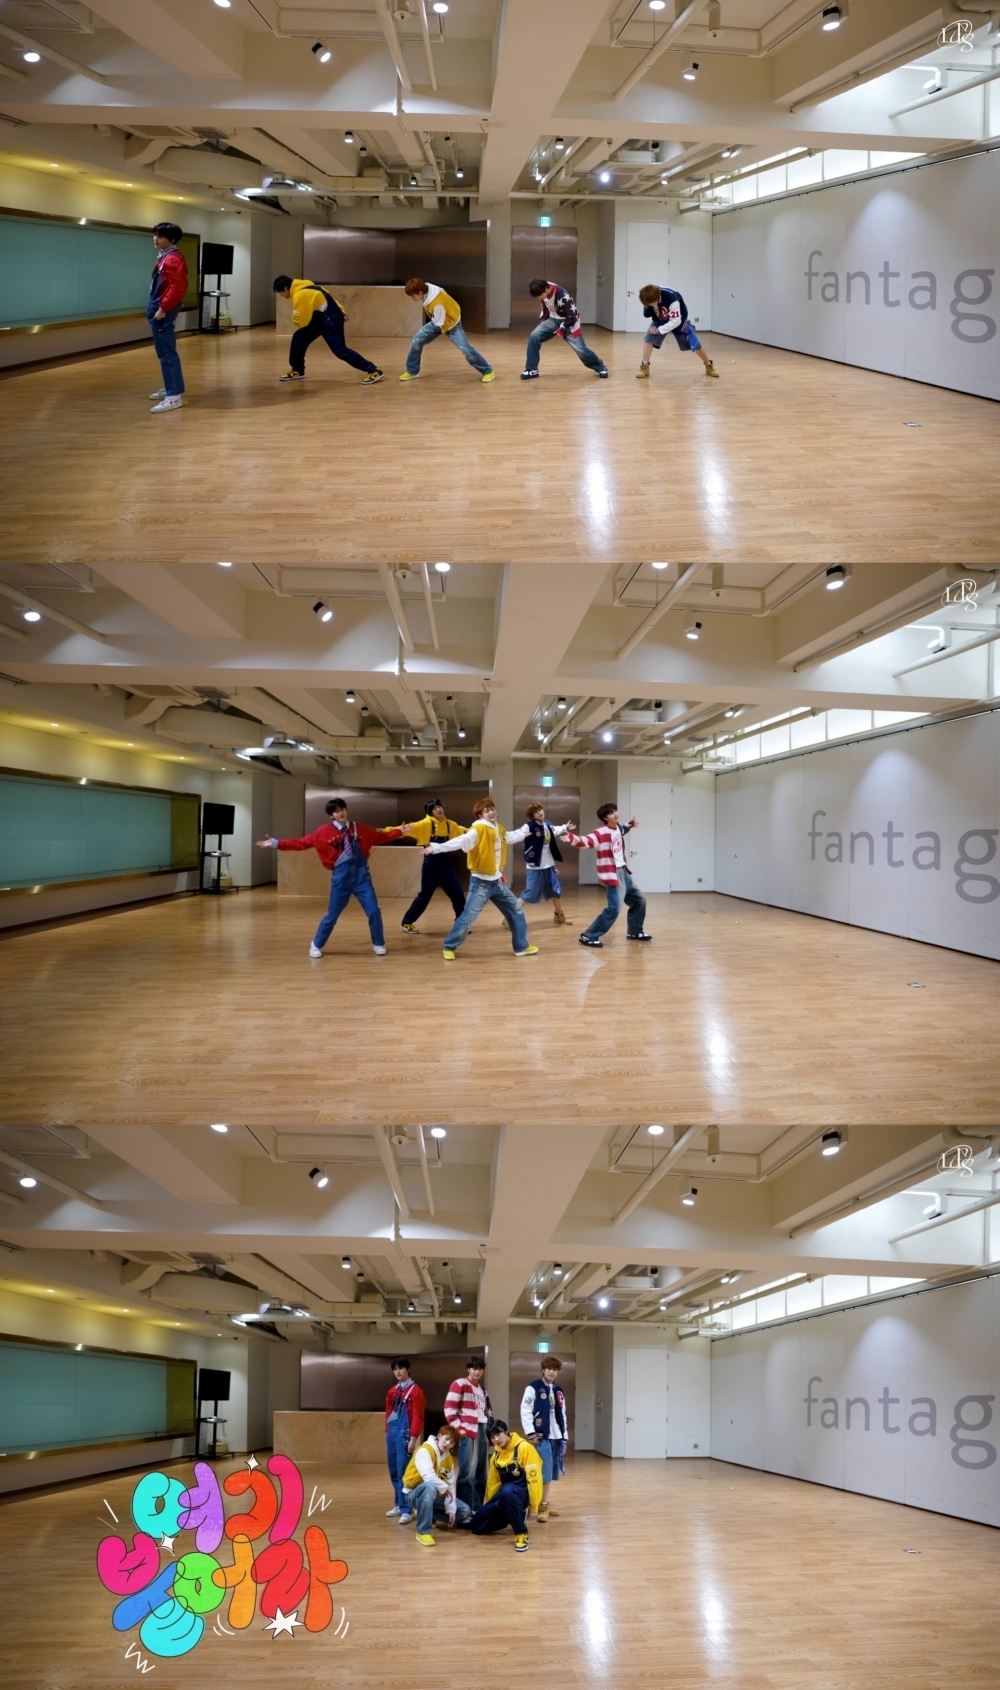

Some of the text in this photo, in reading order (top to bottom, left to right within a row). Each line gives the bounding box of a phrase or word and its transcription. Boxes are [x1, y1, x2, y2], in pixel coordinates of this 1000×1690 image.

[670, 310, 680, 319] 21
[803, 249, 997, 344] fantag
[807, 809, 1000, 904] fantag
[803, 1375, 997, 1470] fantag
